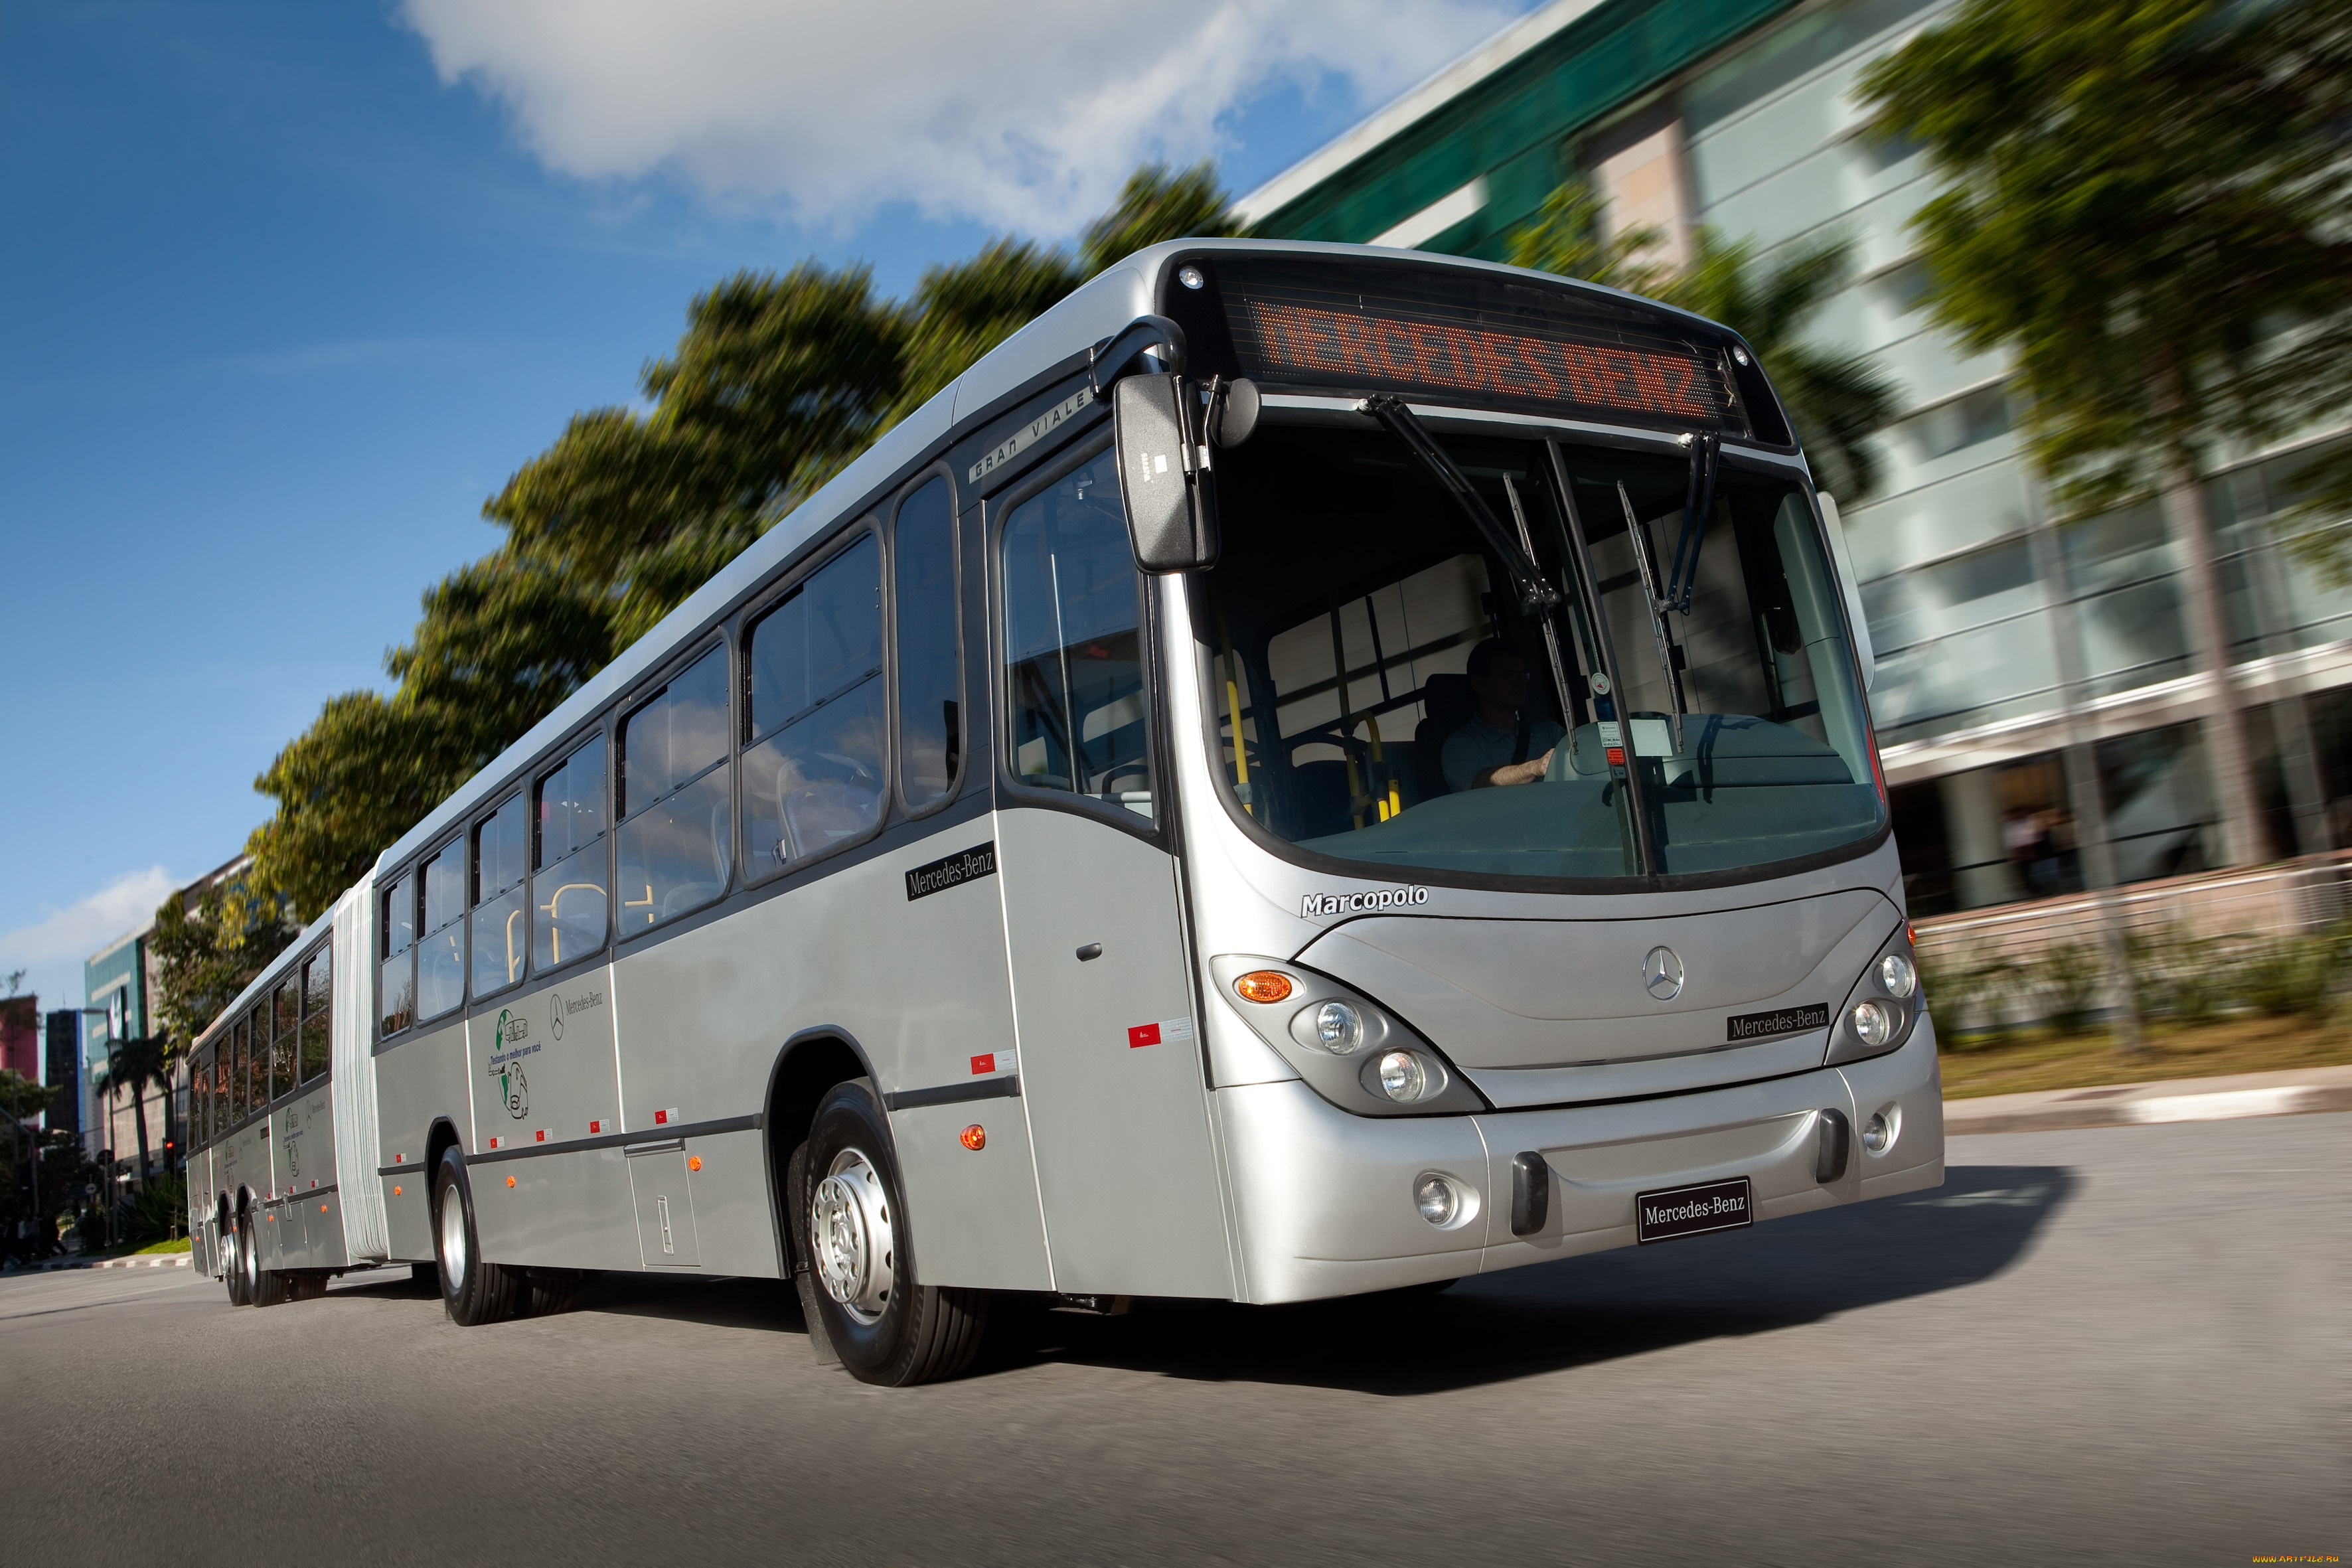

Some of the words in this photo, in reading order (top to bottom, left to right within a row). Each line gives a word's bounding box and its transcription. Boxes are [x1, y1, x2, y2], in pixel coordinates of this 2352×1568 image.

[1257, 301, 1559, 399] MERCEDES
[1561, 342, 1706, 417] BENZ
[1032, 392, 1085, 437] VIALE
[909, 852, 993, 896] Mercedes-Benz
[1301, 885, 1429, 918] Marcopolo
[566, 992, 603, 1016] Mercedes-Benz
[1731, 1008, 1826, 1038] Mercedes-Benz
[490, 1052, 506, 1065] Testando
[509, 1048, 522, 1059] melhor
[522, 1046, 531, 1058] para
[1646, 1194, 1746, 1227] Mercedes-Benz
